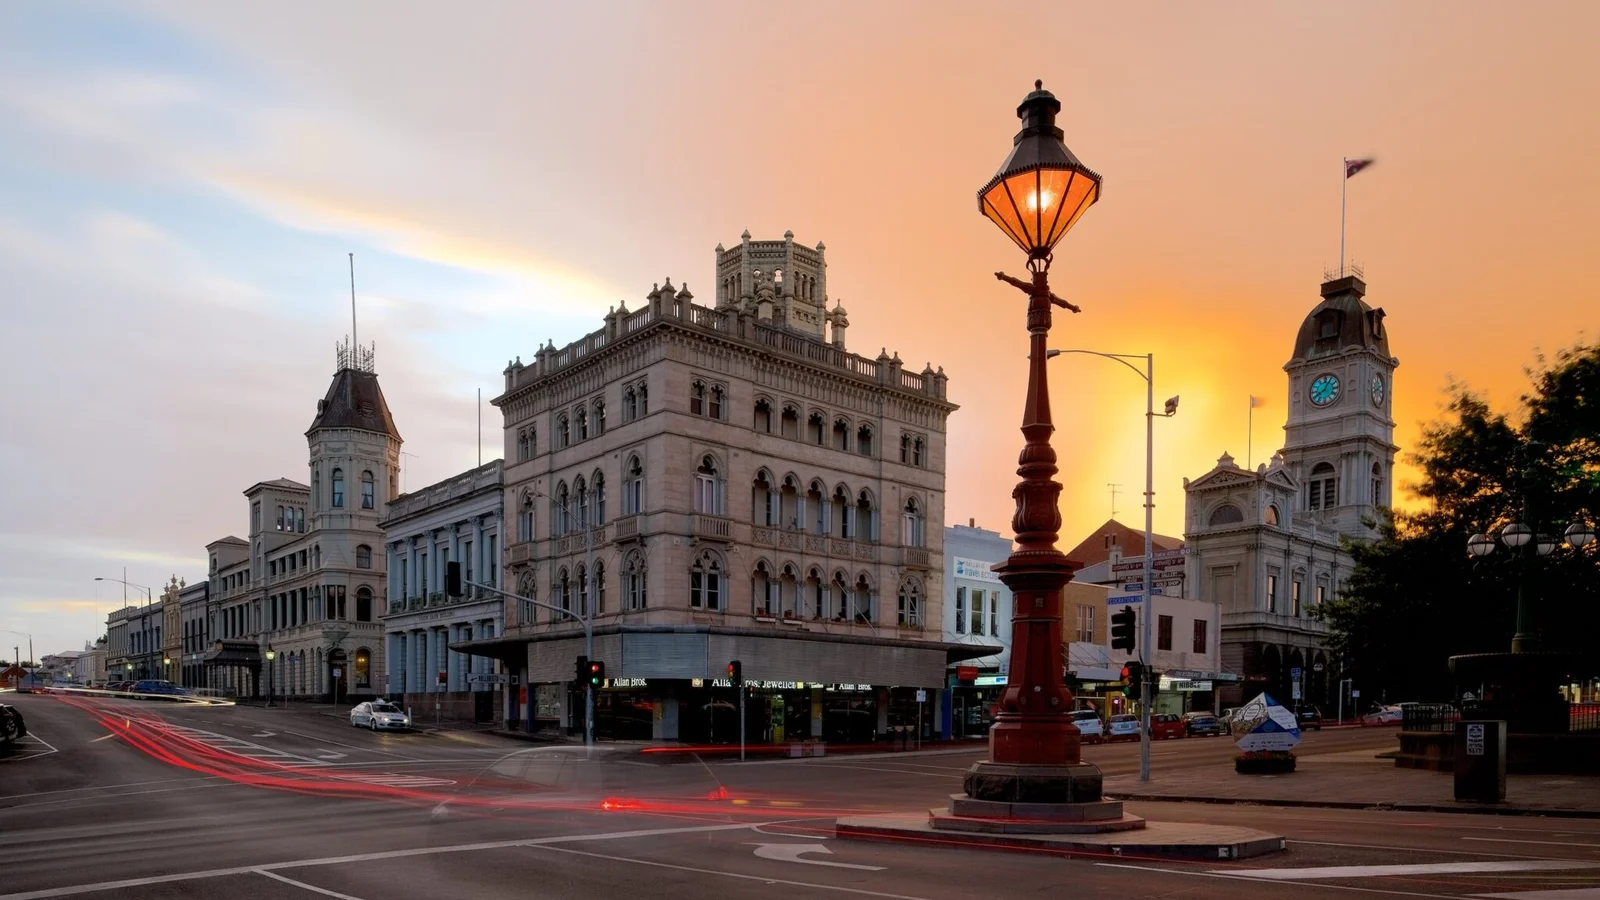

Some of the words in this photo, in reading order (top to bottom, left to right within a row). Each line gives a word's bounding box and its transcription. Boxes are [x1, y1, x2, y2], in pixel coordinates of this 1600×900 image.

[613, 678, 630, 687] Allan
[631, 678, 647, 687] Bros.
[712, 679, 732, 687] Alla
